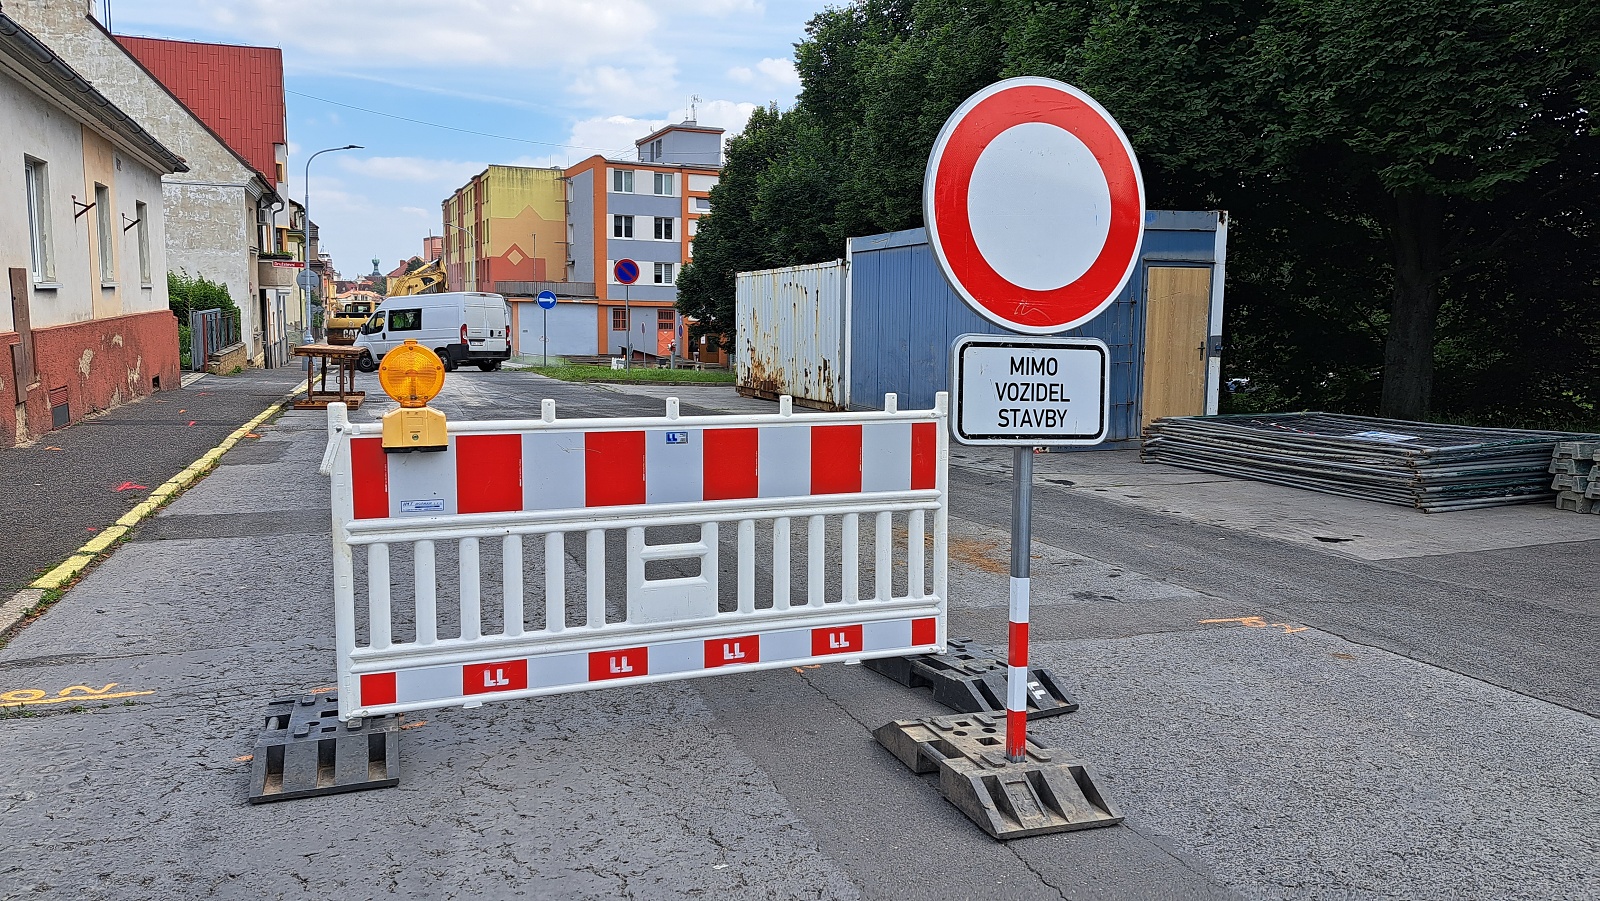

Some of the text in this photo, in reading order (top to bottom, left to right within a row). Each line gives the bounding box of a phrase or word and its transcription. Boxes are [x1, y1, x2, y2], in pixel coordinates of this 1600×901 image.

[343, 329, 359, 339] CAT
[1009, 356, 1058, 376] MIMO
[995, 382, 1071, 402] VOZIDEL
[997, 408, 1068, 428] STAVBY
[829, 632, 849, 649] LL
[723, 642, 745, 660] LL
[610, 656, 633, 674] LL
[484, 668, 510, 687] LL
